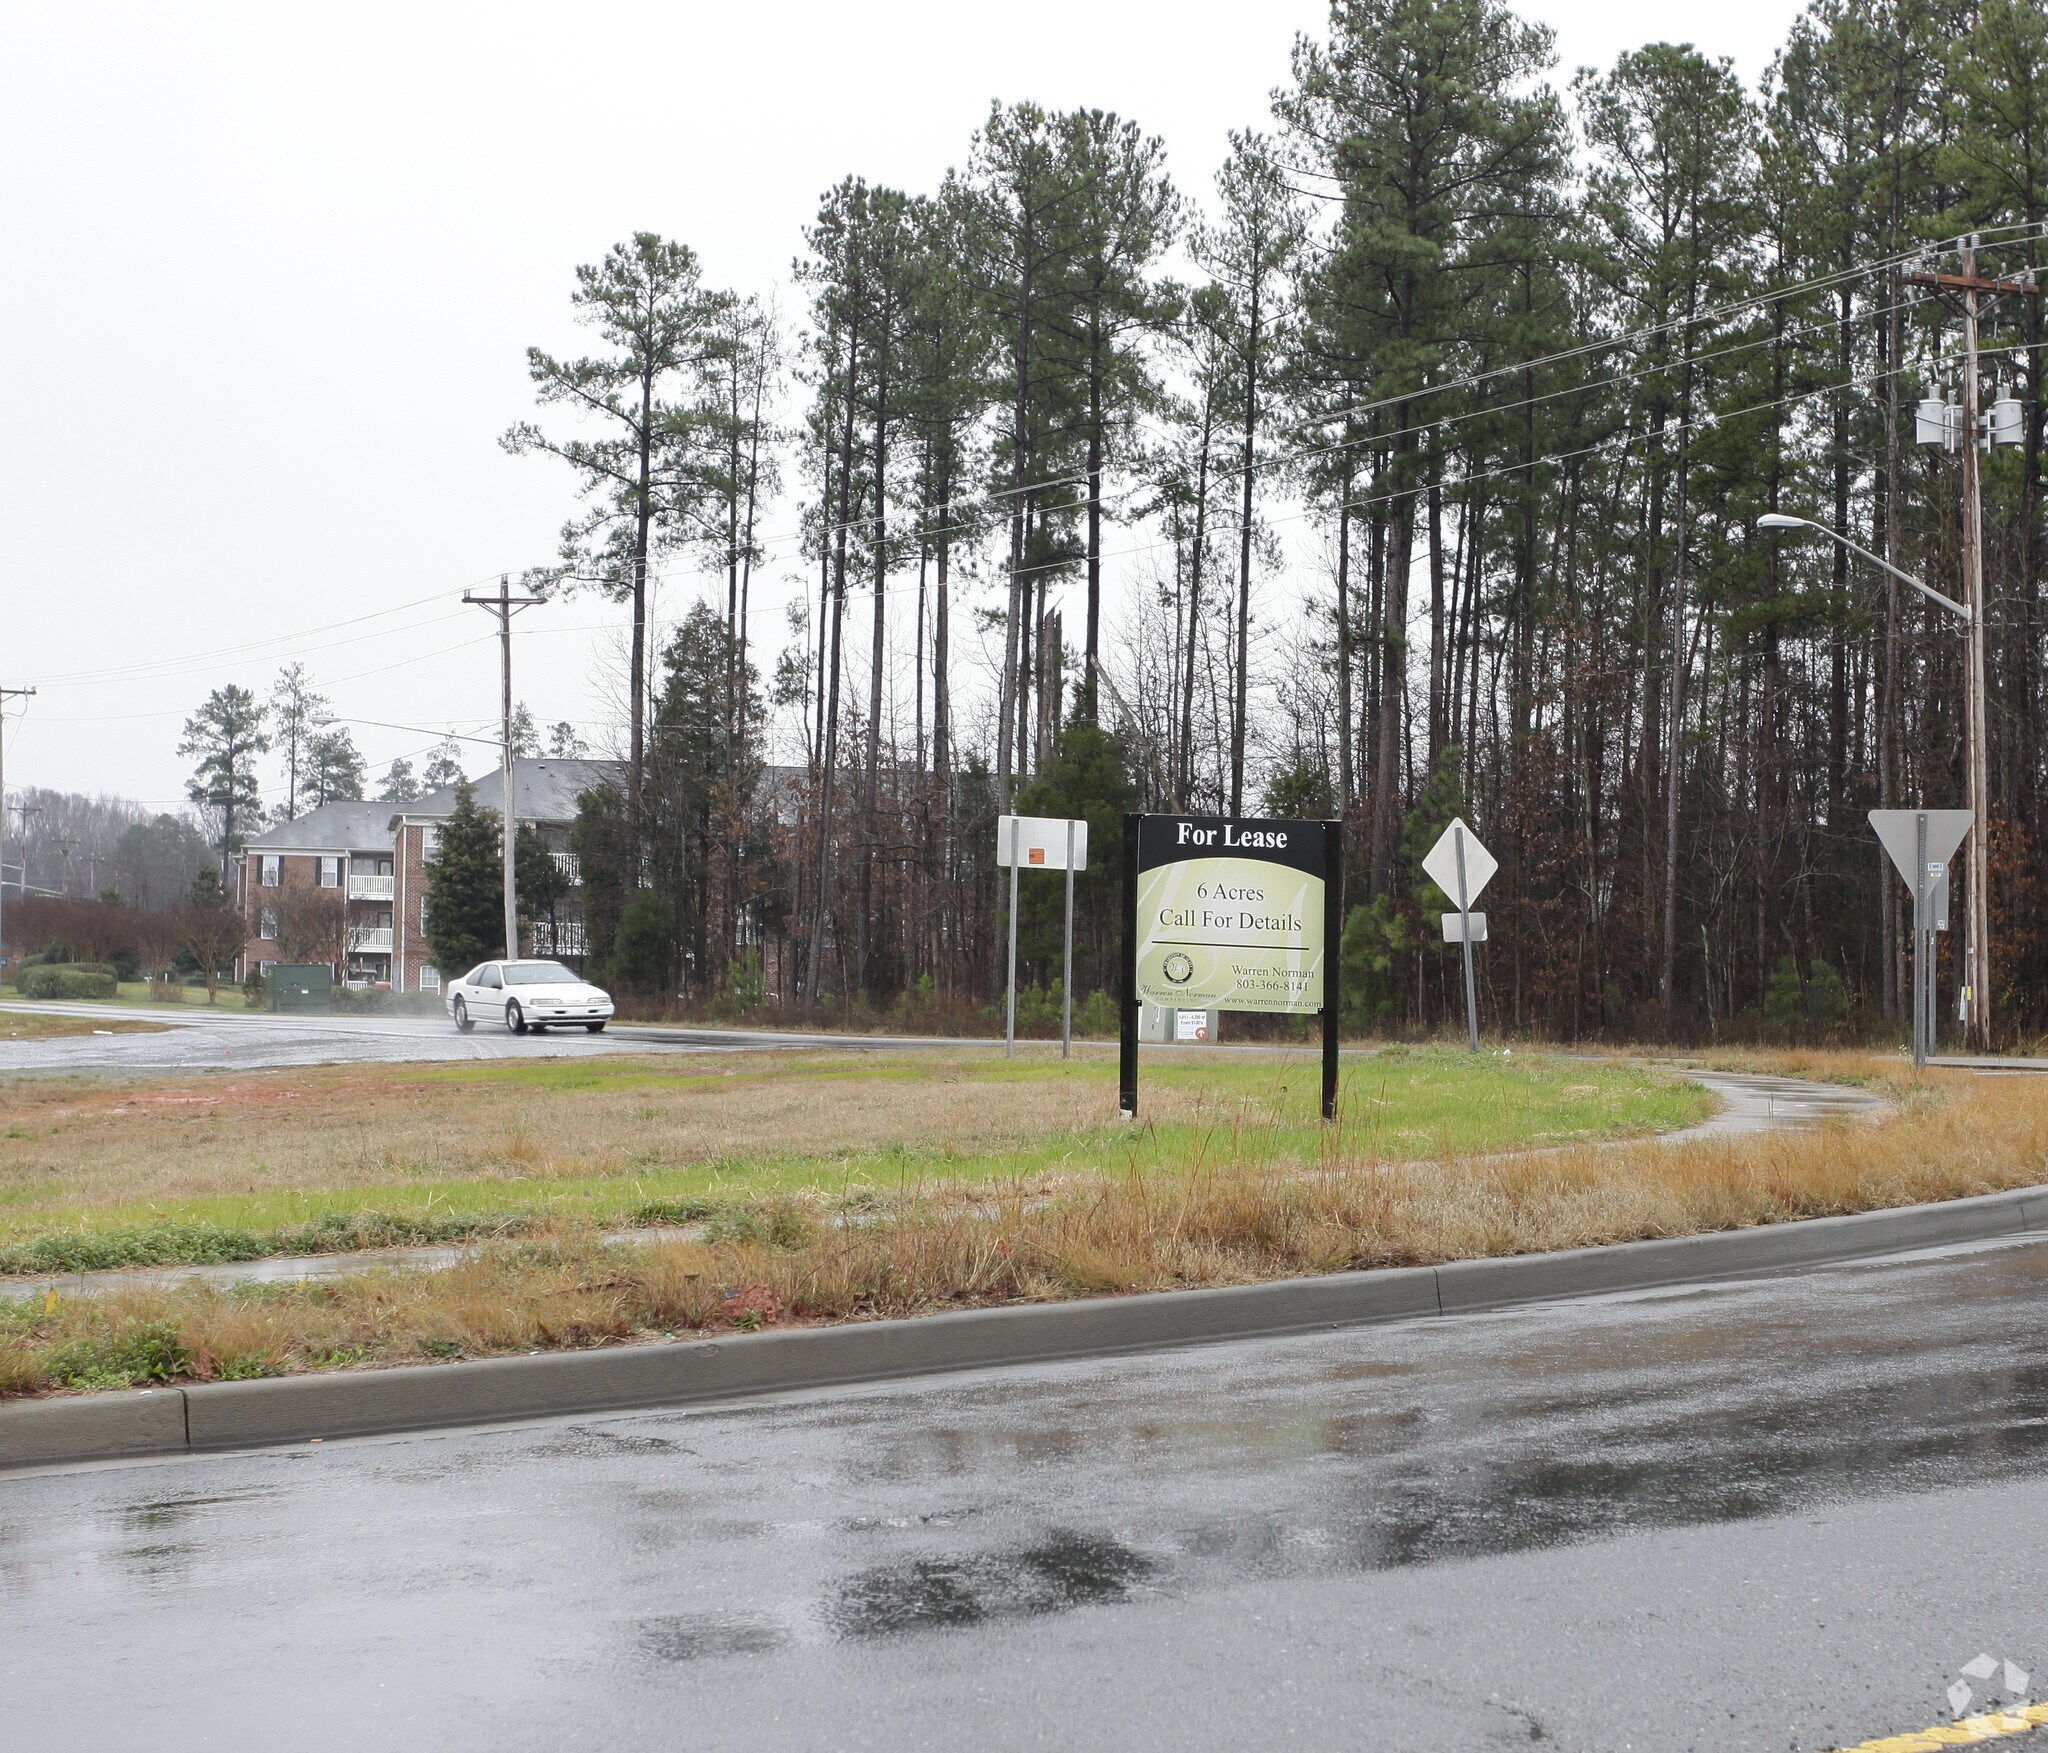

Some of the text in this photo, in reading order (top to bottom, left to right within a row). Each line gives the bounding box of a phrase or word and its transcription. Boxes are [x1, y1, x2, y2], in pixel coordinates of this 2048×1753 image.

[1176, 822, 1288, 849] For Lease
[1197, 882, 1264, 901] 6 Acres
[1159, 909, 1302, 931] Call For Details
[1232, 965, 1315, 978] Warren Norman
[1236, 979, 1308, 992] 803-366-8141
[1224, 998, 1322, 1008] www.warrennorman.com
